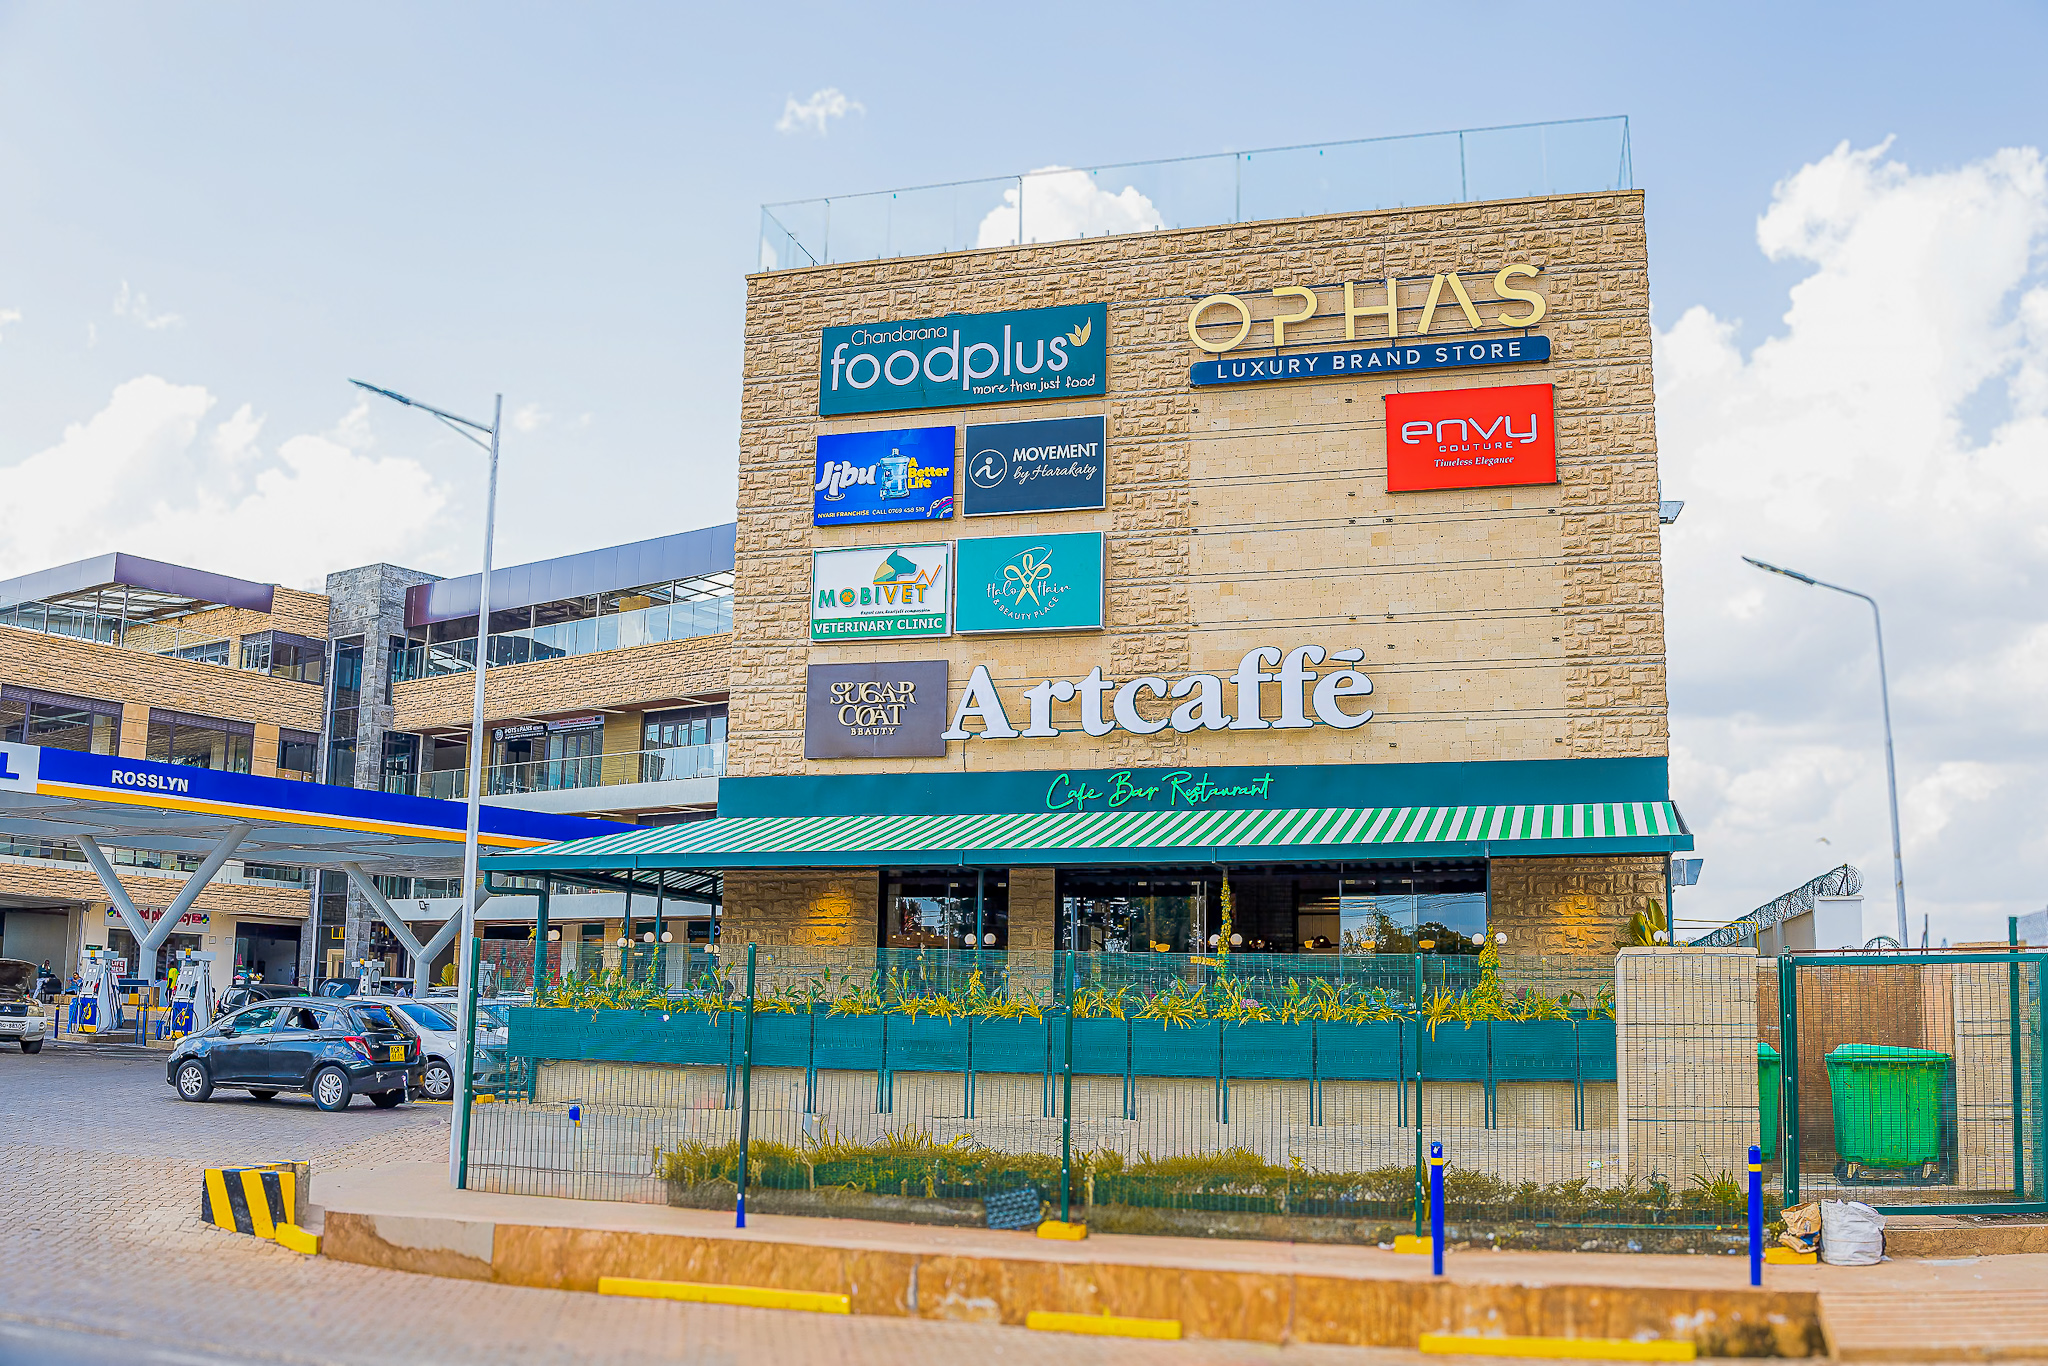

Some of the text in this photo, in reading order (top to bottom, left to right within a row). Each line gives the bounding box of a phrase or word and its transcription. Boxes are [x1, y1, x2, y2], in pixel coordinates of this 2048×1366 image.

[1188, 263, 1547, 353] OPHAS
[851, 326, 948, 346] Chandarana
[830, 324, 1069, 391] foodplus
[1217, 341, 1521, 379] LUXURY BRAND STORE
[972, 374, 1096, 395] more than just food
[1401, 413, 1538, 444] envy
[1012, 442, 1099, 462] MOVEMENT
[1439, 441, 1514, 453] COUTURE
[907, 457, 919, 468] A
[907, 466, 950, 478] Better
[1013, 461, 1098, 485] by Harakaty
[1434, 455, 1515, 468] Timeless Elegance
[814, 460, 878, 497] Jibu
[907, 477, 932, 489] Life
[836, 510, 870, 518] FRANCHISE
[818, 584, 928, 608] MOBIVET
[998, 604, 1031, 620] BEAUTY
[1033, 596, 1059, 618] PLACE
[814, 618, 943, 634] VETERINARY CLINIC
[829, 681, 918, 705] SUGAR
[940, 644, 1375, 741] Artcaffé
[838, 703, 907, 727] COAT
[111, 769, 189, 793] ROSSLYN
[1046, 770, 1275, 811] Cafe Bar Restaurant
